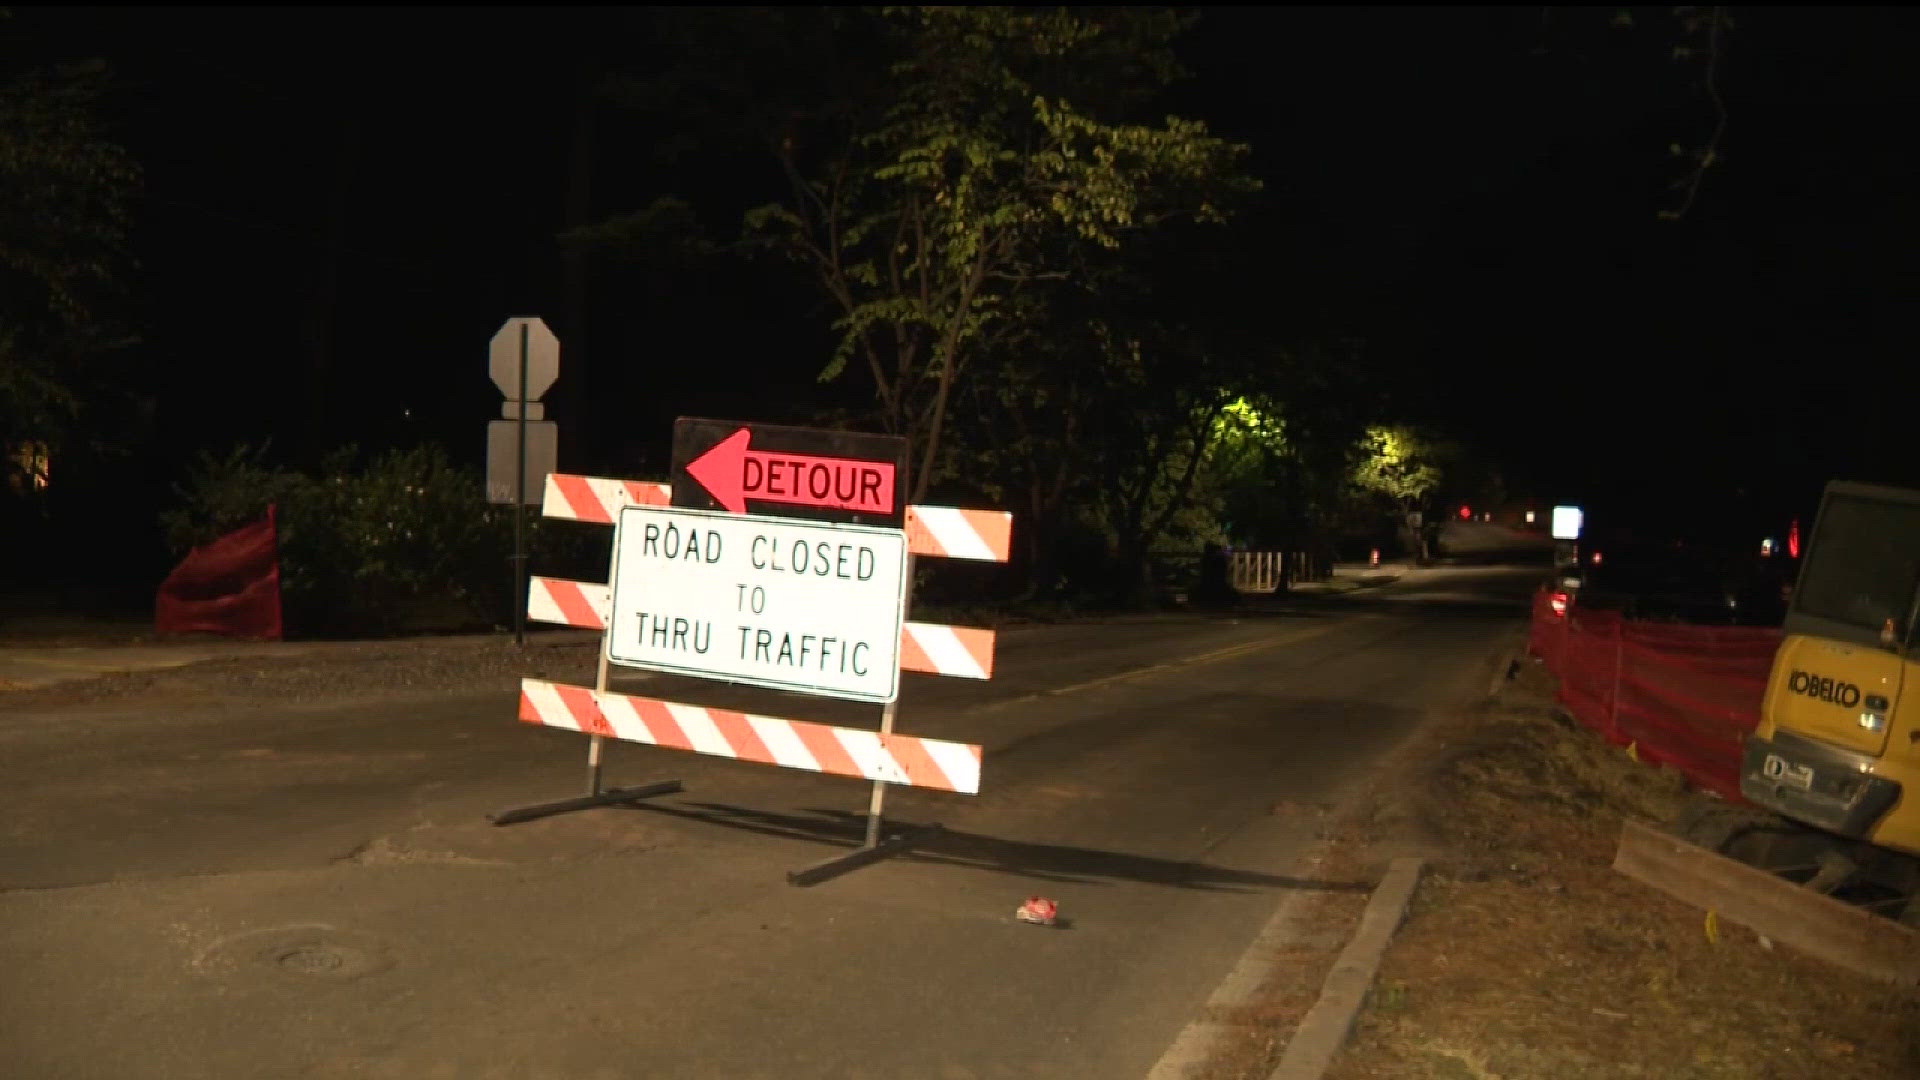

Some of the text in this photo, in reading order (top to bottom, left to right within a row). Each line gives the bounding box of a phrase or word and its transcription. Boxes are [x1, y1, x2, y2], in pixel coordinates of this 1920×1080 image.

[743, 456, 882, 505] DETOUR
[643, 523, 875, 581] ROAD CLOSED
[737, 583, 766, 615] TO
[636, 612, 869, 677] THRU TRAFFIC
